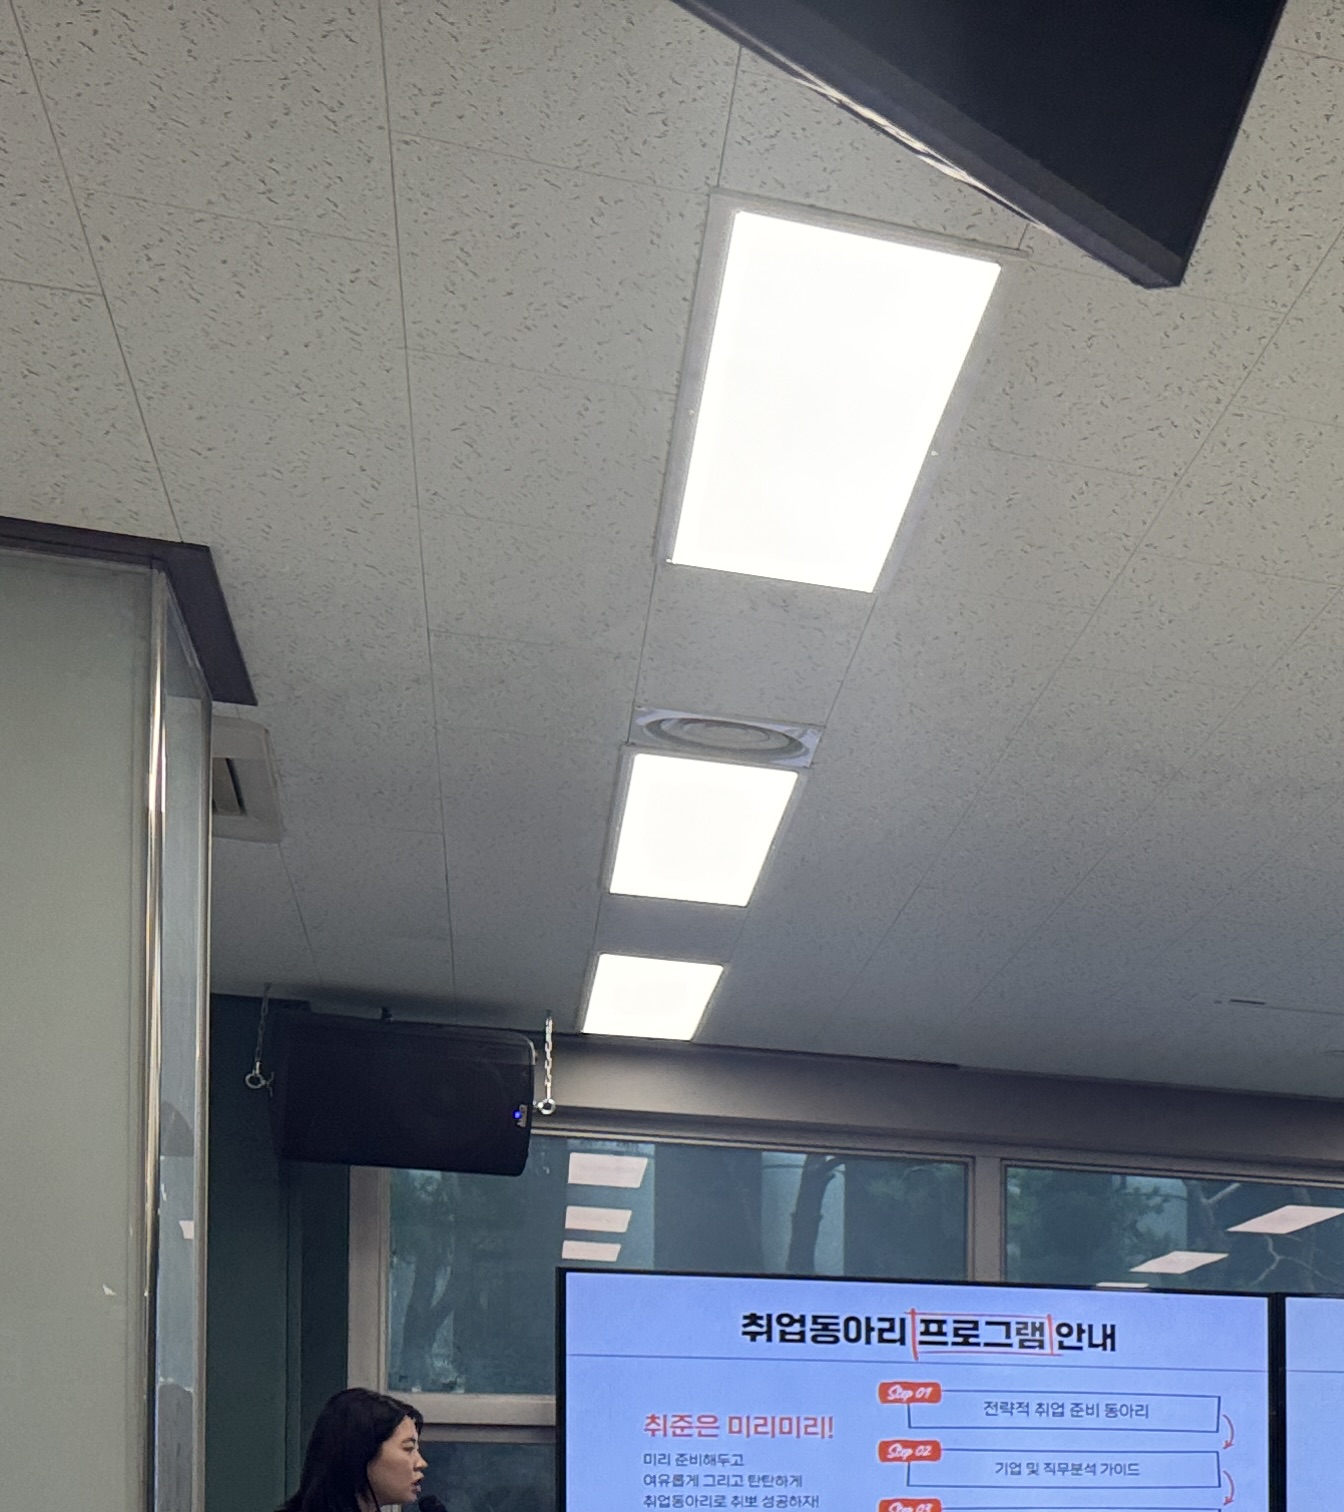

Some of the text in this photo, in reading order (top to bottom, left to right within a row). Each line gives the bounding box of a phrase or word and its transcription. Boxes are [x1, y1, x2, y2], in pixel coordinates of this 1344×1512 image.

[741, 1312, 1117, 1353] 취업동아리 프로그램 안내
[887, 1384, 933, 1401] Step 01
[983, 1400, 1150, 1420] 전략적 취업 준비 동아리
[643, 1413, 834, 1440] 취준은 미리미리!
[643, 1452, 745, 1467] 미리 준비해두고
[887, 1442, 933, 1460] Step 02
[995, 1461, 1141, 1477] 기업 및 직무분석 가이드
[703, 1473, 745, 1488] 그리고
[747, 1474, 803, 1489] 탄탄하게
[643, 1494, 728, 1509] 취업동아리로
